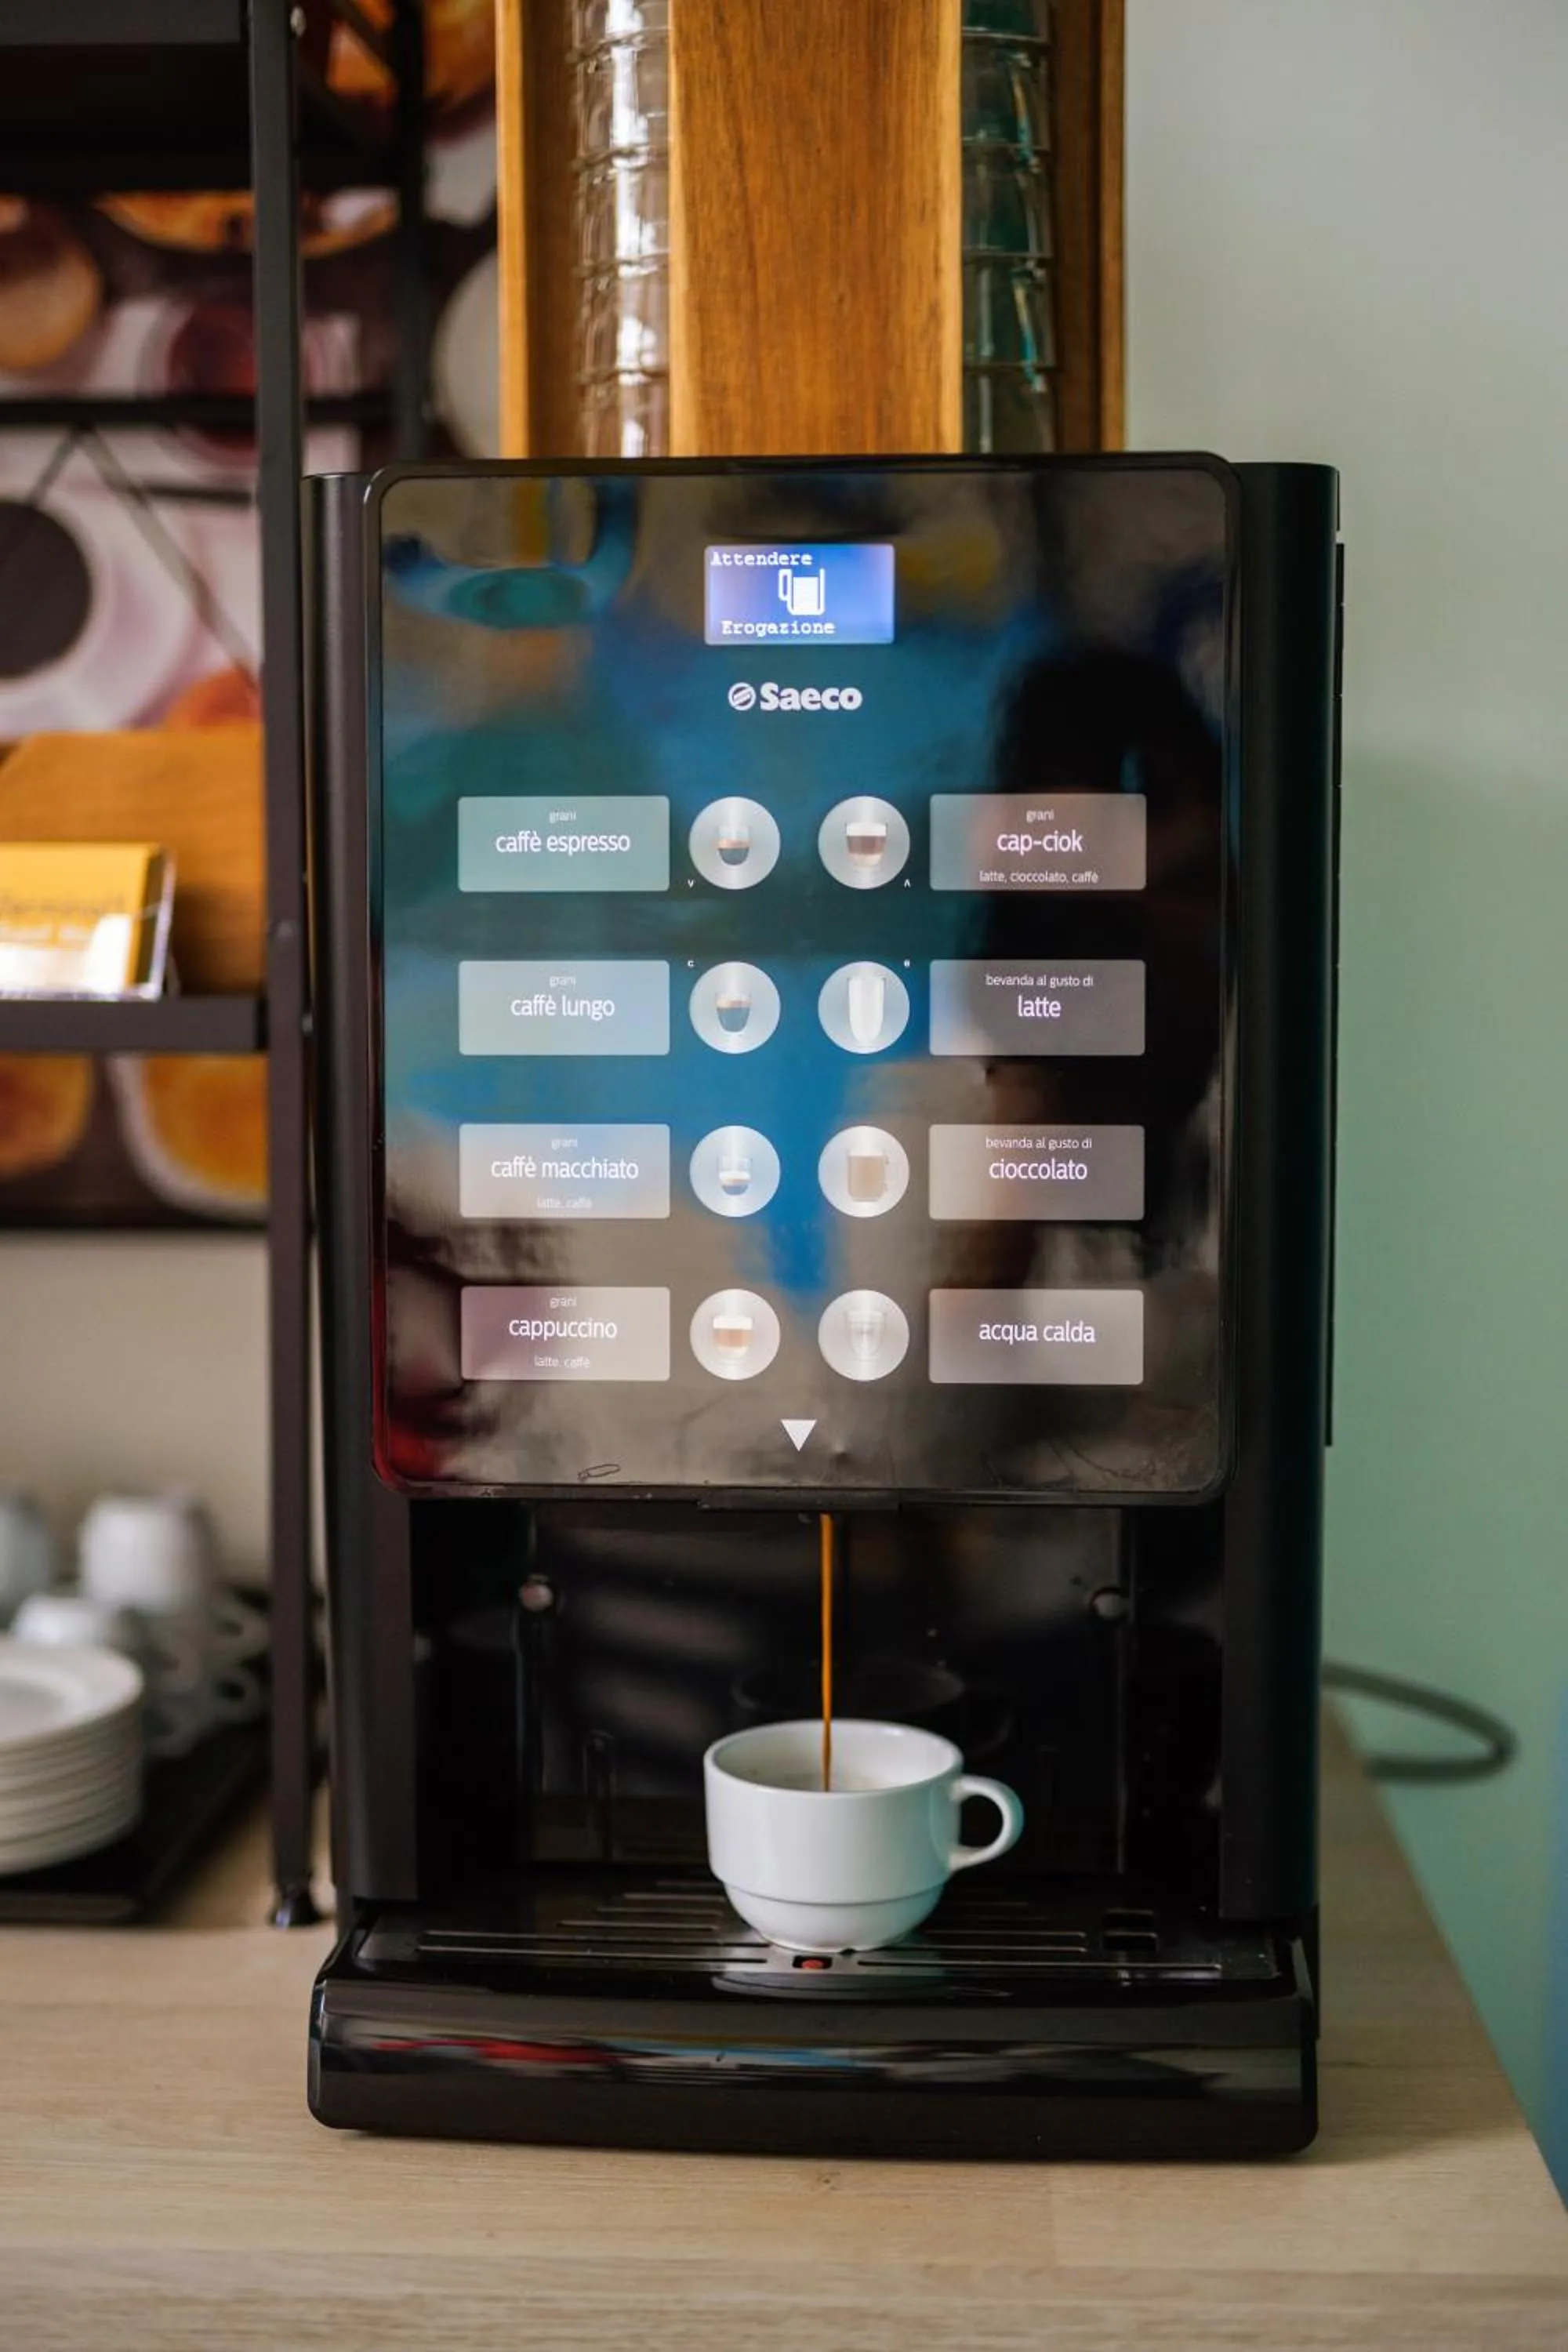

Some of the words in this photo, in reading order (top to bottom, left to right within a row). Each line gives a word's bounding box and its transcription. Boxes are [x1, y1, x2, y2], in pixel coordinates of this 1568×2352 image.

[710, 551, 813, 565] Attendere
[721, 620, 836, 637] Erogazione
[760, 682, 862, 710] Saeco
[1026, 809, 1054, 823] grani
[495, 830, 542, 853] caffè
[546, 834, 630, 857] espresso
[996, 829, 1083, 856] cap-ciok
[1010, 871, 1069, 883] cioccolato,
[1072, 870, 1098, 883] caffè
[985, 974, 1034, 985] bevanda
[1036, 975, 1047, 985] al
[1050, 976, 1080, 988] gusto
[1083, 975, 1094, 986] di
[510, 994, 557, 1017] caffè
[561, 994, 615, 1021] lungo
[1018, 995, 1062, 1017] latte
[985, 1138, 1033, 1149] bevanda
[1036, 1138, 1046, 1149] al
[1048, 1138, 1080, 1151] gusto
[1081, 1138, 1092, 1149] di
[491, 1156, 537, 1178] caffè
[542, 1156, 639, 1180] macchiato
[989, 1158, 1088, 1180] cioccolato
[550, 1296, 577, 1308] grani
[509, 1318, 618, 1341] cappuccino
[978, 1323, 1039, 1345] acqua
[1043, 1319, 1097, 1343] calda
